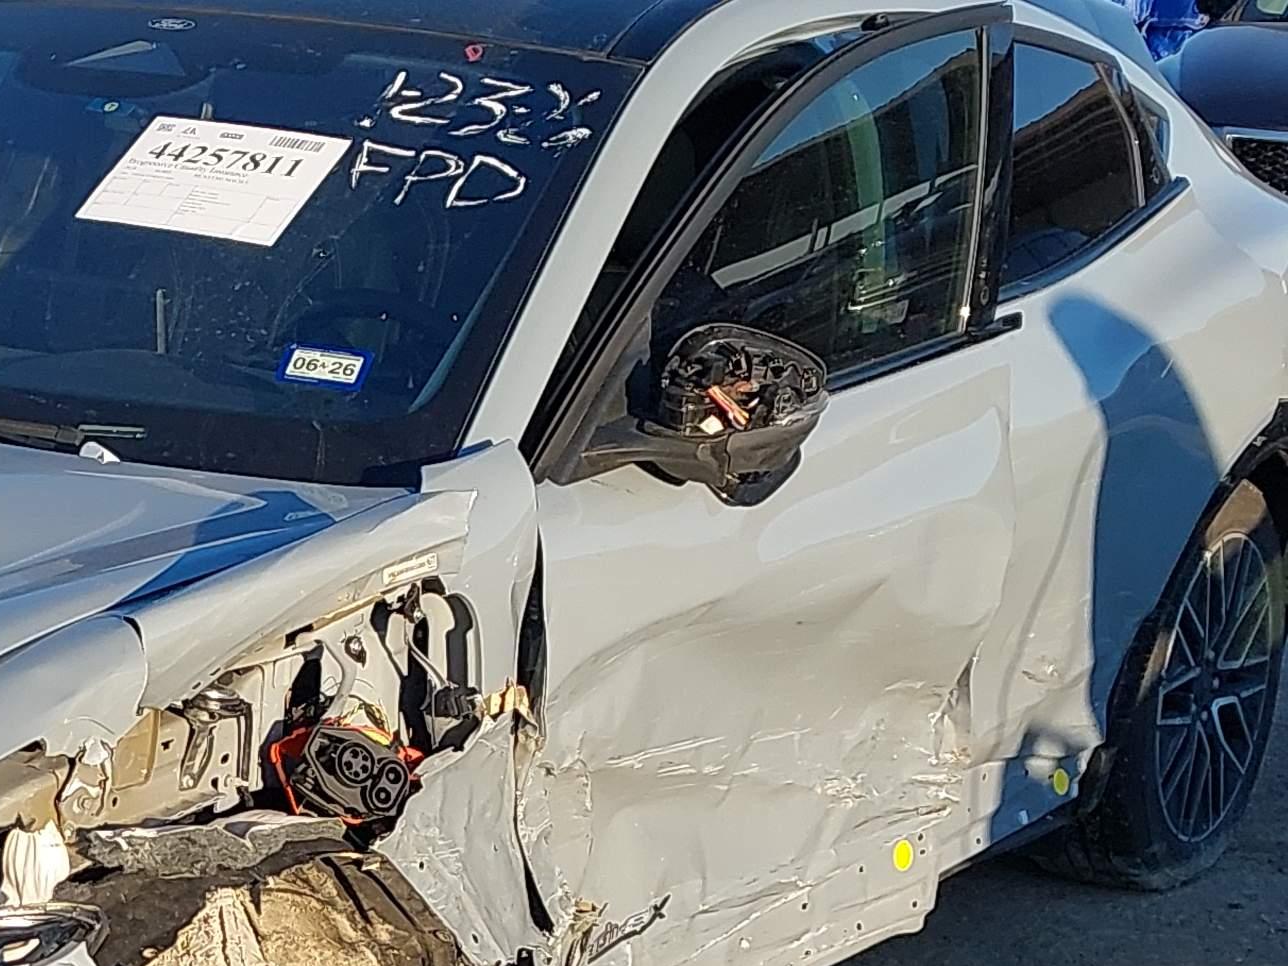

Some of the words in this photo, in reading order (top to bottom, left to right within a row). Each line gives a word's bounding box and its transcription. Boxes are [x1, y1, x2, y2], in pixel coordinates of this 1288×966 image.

[148, 141, 304, 178] 44257811
[349, 139, 527, 208] FPD
[292, 356, 320, 372] 06
[327, 361, 357, 377] 26
